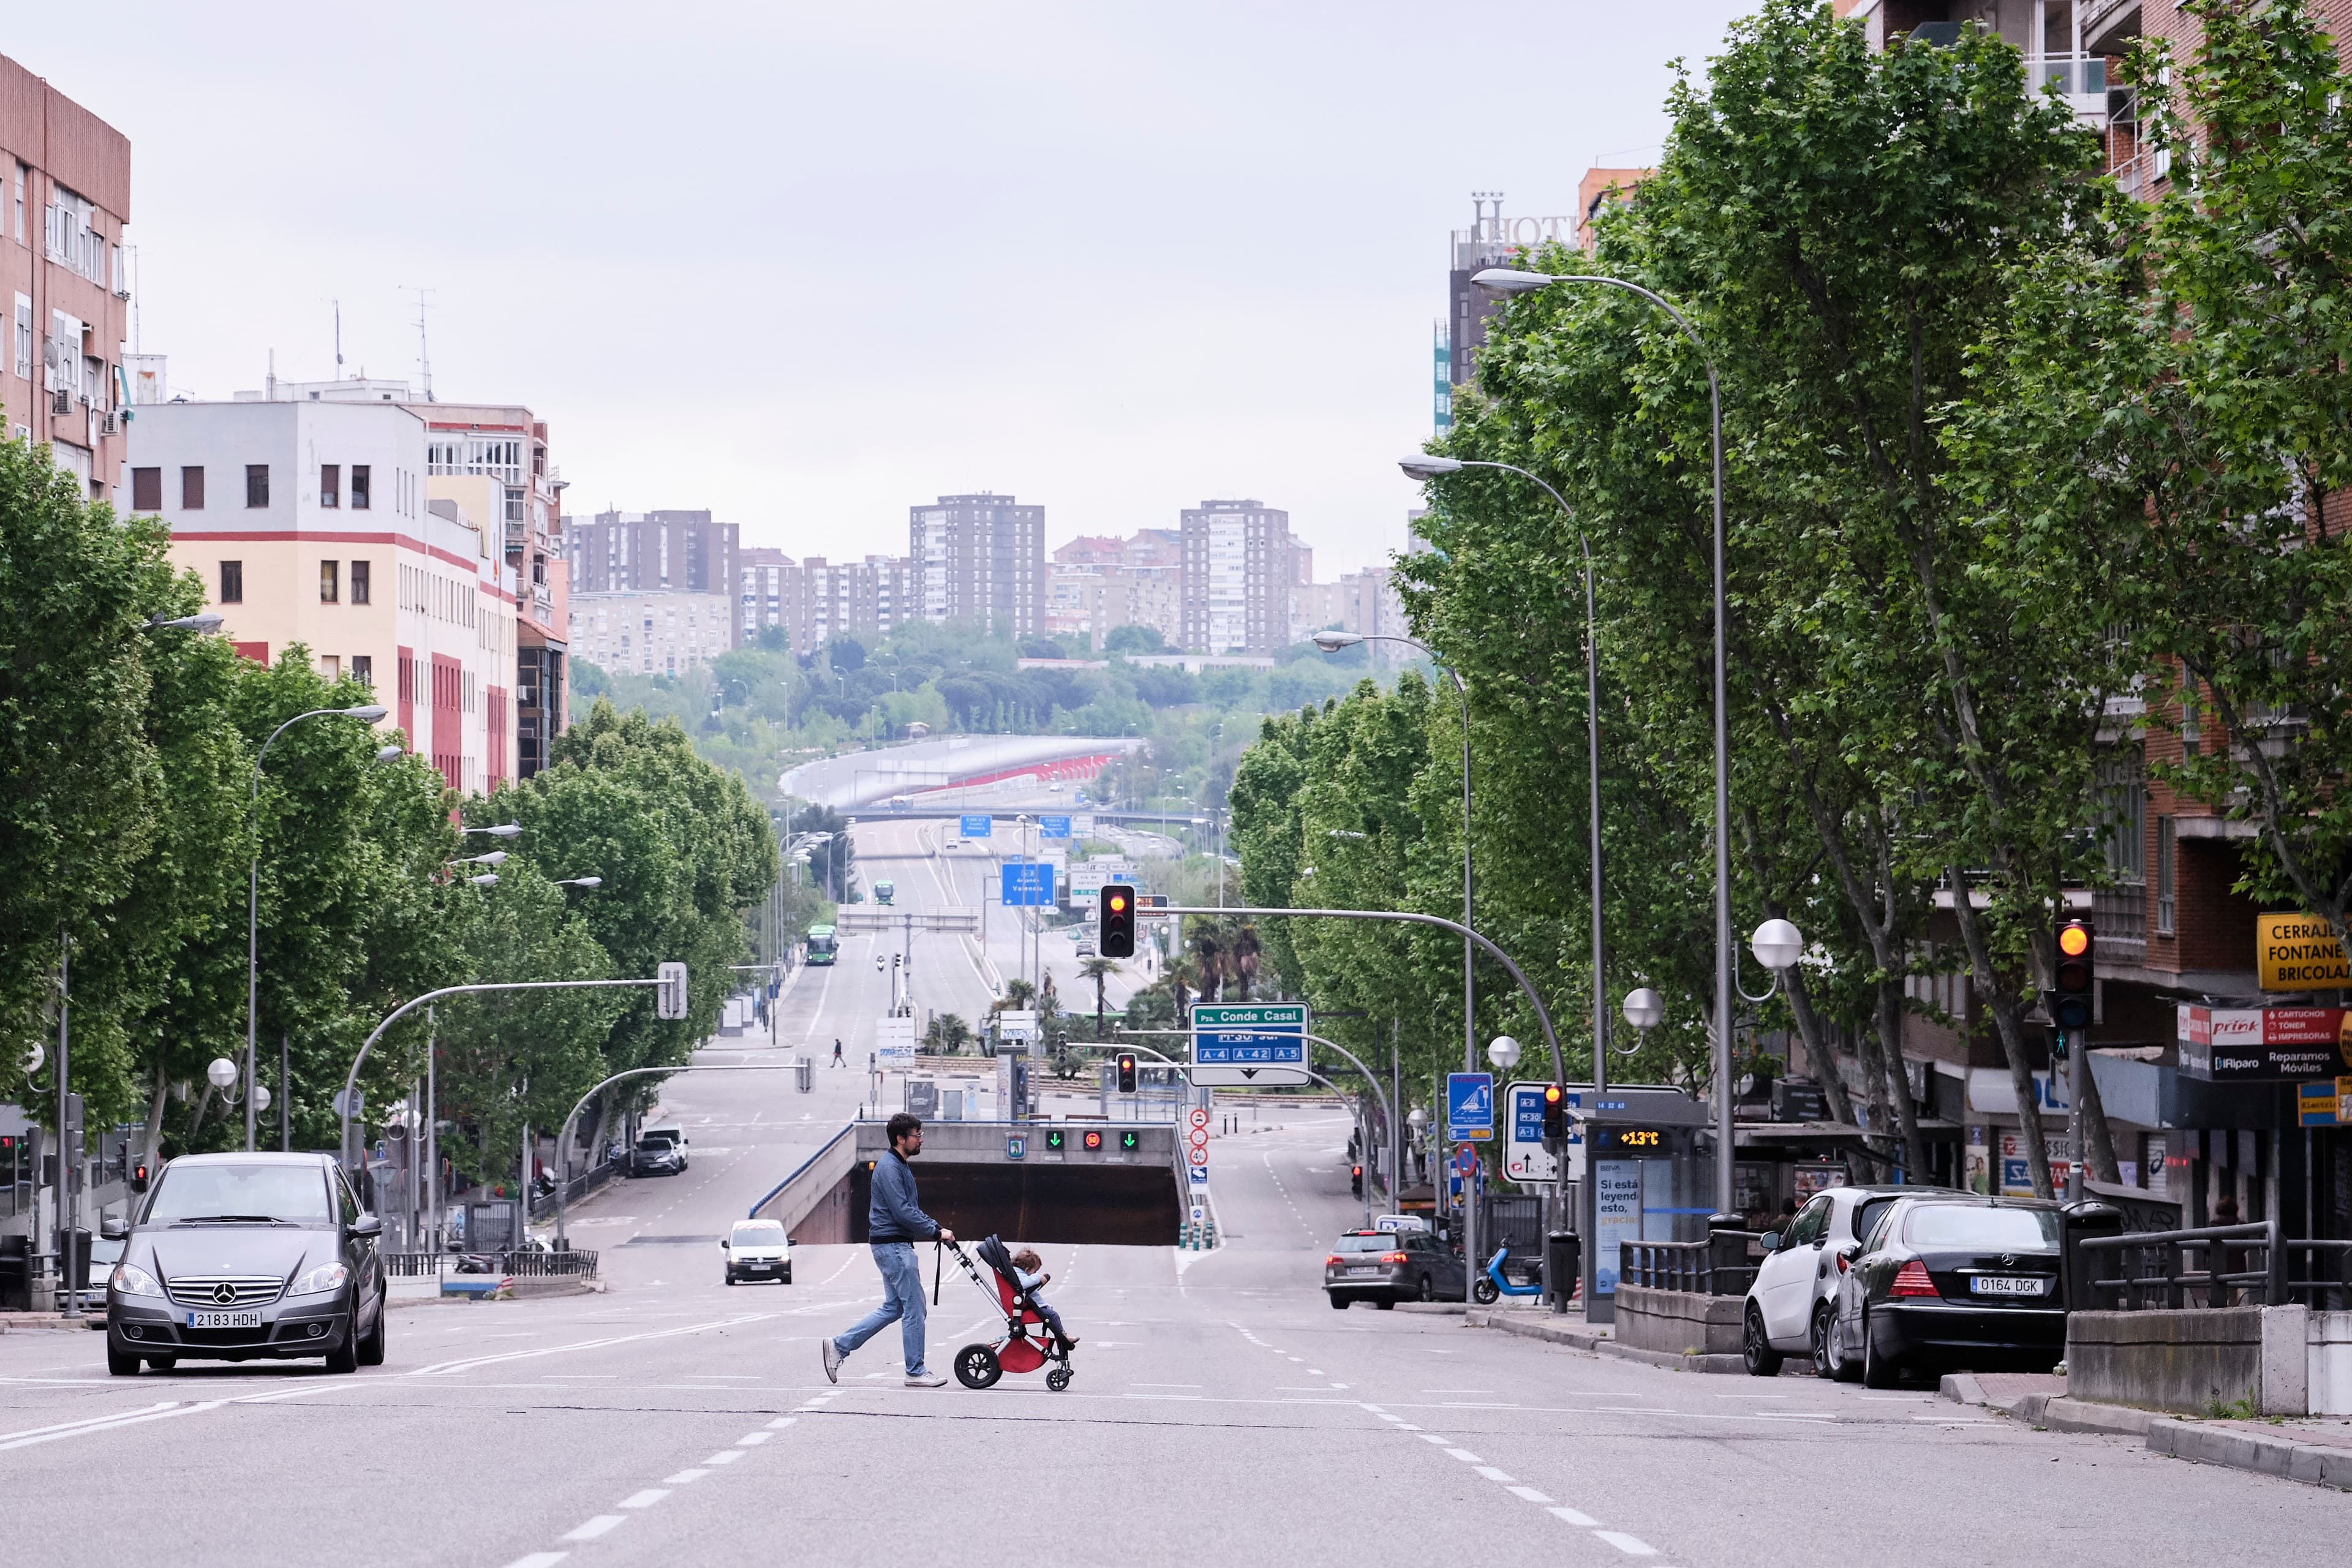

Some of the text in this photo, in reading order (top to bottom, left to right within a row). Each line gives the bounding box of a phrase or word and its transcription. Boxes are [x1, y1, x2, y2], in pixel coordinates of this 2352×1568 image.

[2269, 944, 2346, 960] FONTANE
[1220, 1011, 1258, 1022] Conde
[1264, 1011, 1297, 1021] Casal
[2213, 1020, 2260, 1035] prink
[1236, 1050, 1268, 1058] A-42
[1278, 1049, 1297, 1058] A-5
[2269, 1052, 2330, 1062] Reparamos
[2280, 1062, 2322, 1073] Móviles
[1600, 1179, 1638, 1189] Si está
[1600, 1192, 1638, 1203] leyend
[1600, 1204, 1627, 1213] esto,
[1981, 1279, 2037, 1292] 0164 DGK
[197, 1314, 257, 1326] 2183 HDH
